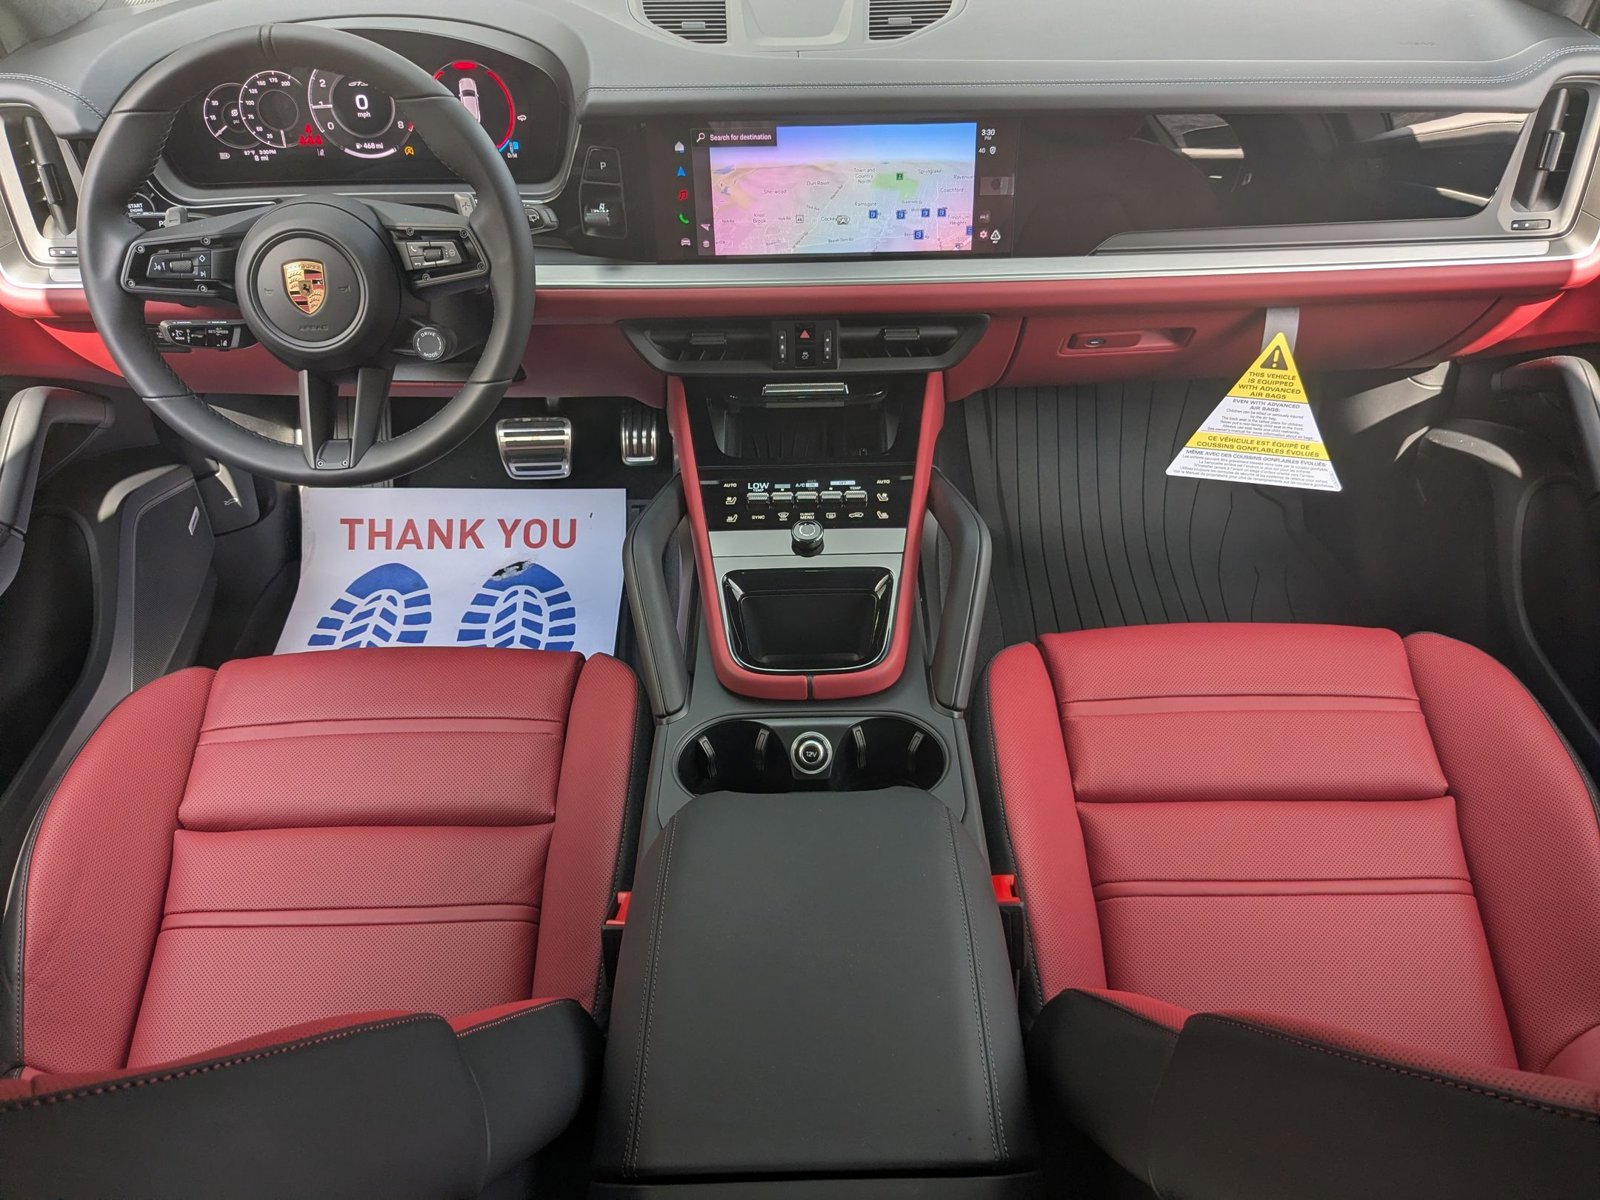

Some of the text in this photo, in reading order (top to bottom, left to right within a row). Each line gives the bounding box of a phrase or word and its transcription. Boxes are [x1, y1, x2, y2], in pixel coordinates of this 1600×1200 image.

[319, 79, 326, 88] 2
[355, 94, 368, 110] 0
[327, 122, 334, 130] 0
[398, 120, 404, 129] 8
[600, 162, 606, 170] P
[1257, 378, 1294, 387] EQUIPPED
[1260, 386, 1301, 394] ADVANCED
[1265, 392, 1286, 400] BAGS
[1220, 435, 1255, 445] VÉHICULE
[1272, 440, 1298, 449] ÉQUIPÉ
[1196, 441, 1320, 458] COUSSINS GONFLABLES ÉVOLUÉS
[1233, 454, 1262, 462] COUSSINS
[1263, 456, 1299, 464] GONFLABLES
[748, 482, 770, 490] LOW
[340, 518, 577, 550] THANK YOU
